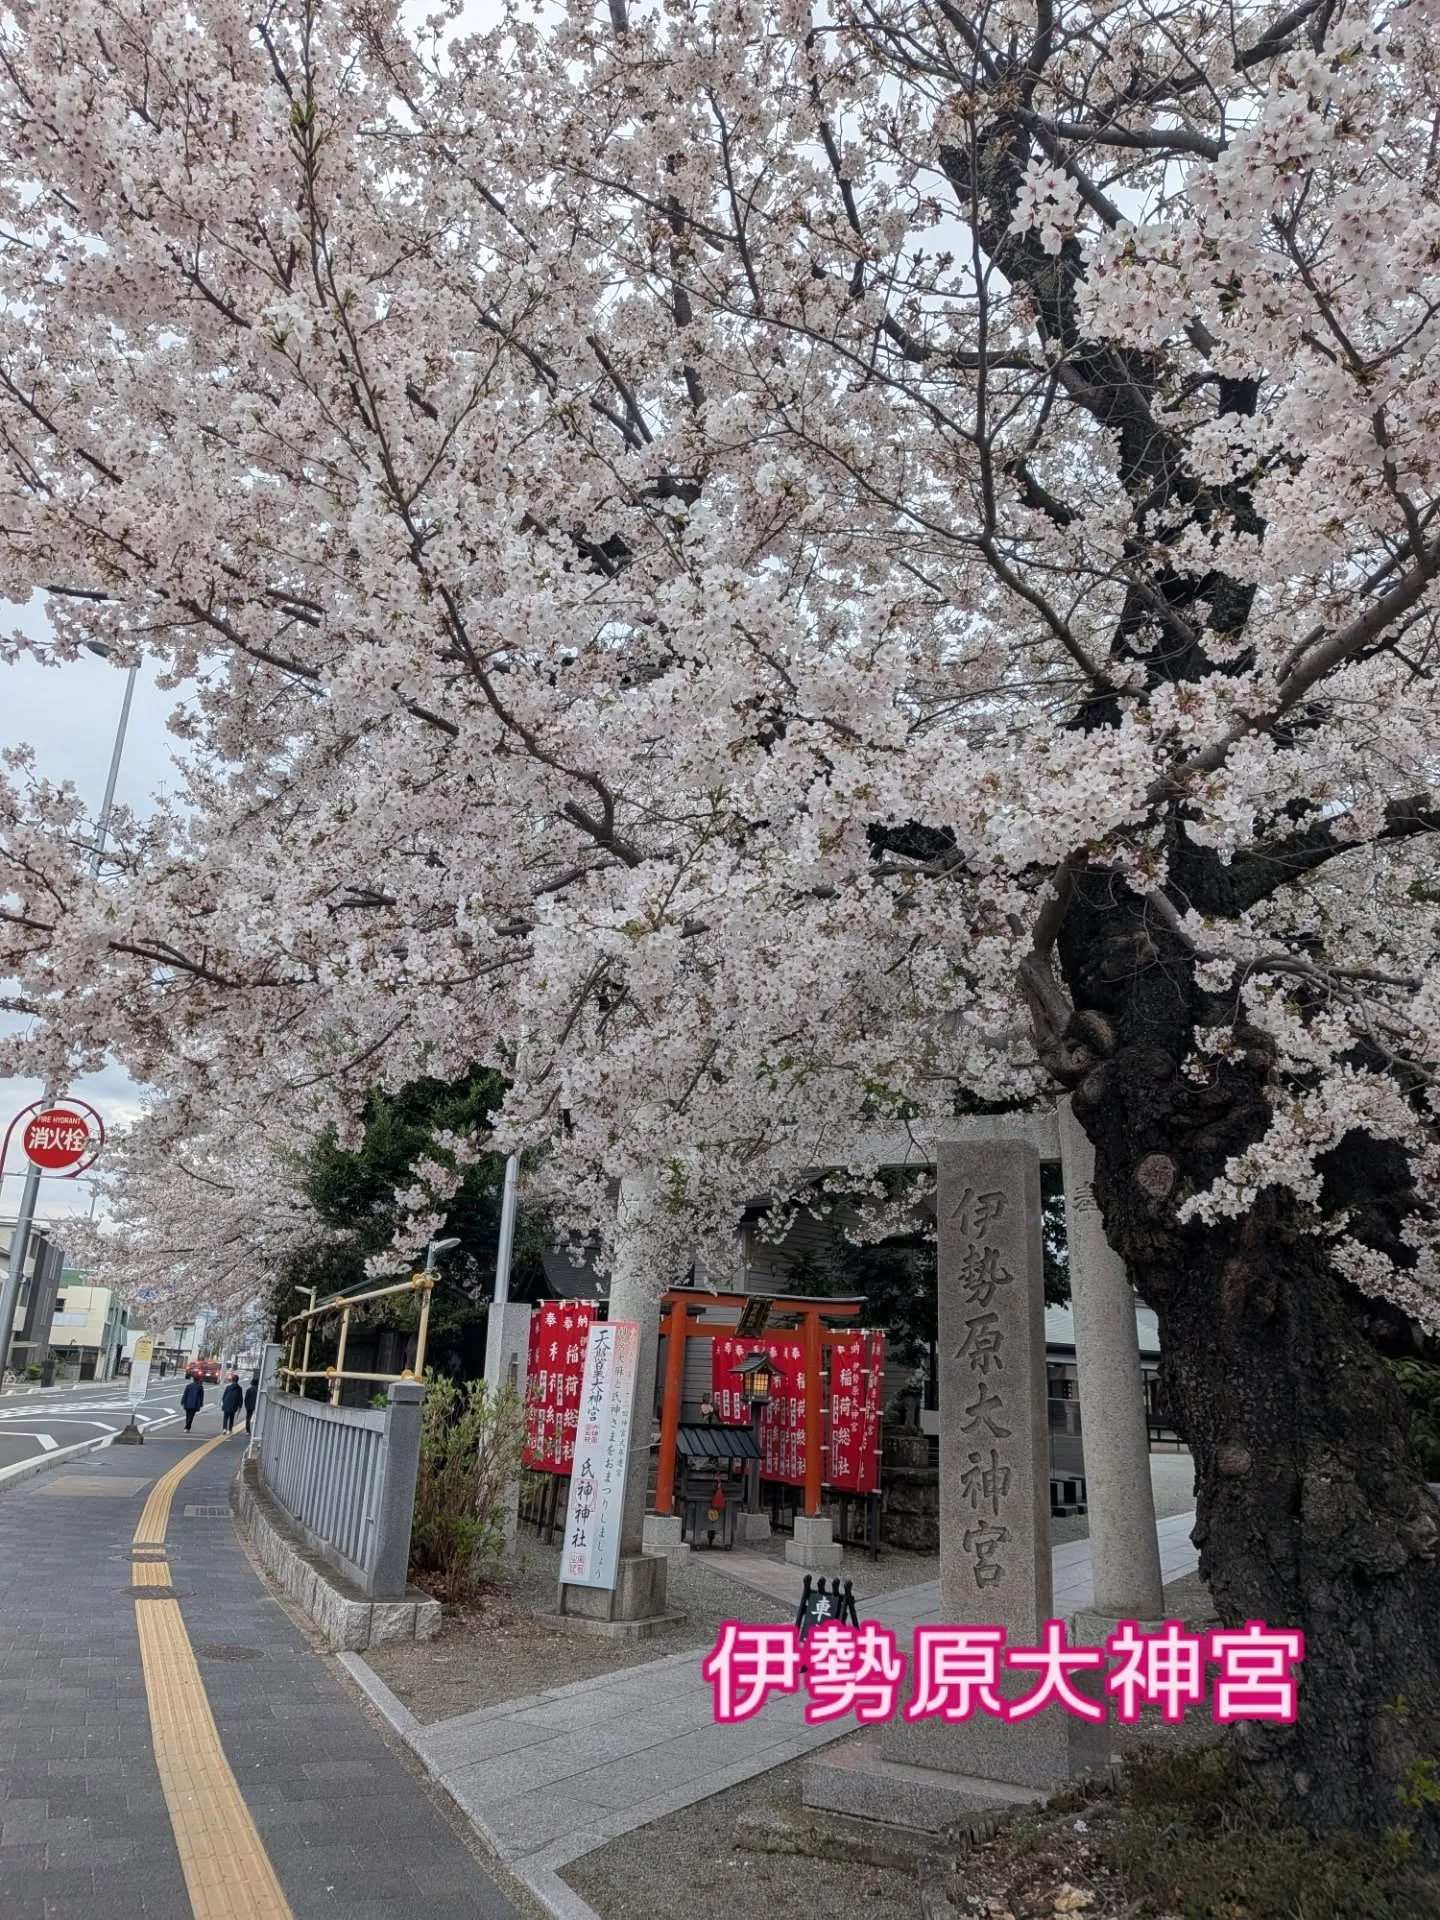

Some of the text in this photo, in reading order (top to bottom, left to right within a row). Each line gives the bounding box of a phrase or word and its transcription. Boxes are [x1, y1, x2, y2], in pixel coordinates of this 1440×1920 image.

[28, 1126, 85, 1151] 消火栓
[37, 1115, 81, 1125] FIRE HYDRANT
[585, 1328, 612, 1422] 天照皇大神宮
[838, 1368, 853, 1476] 稲荷総社
[571, 1457, 595, 1549] 氏神神社
